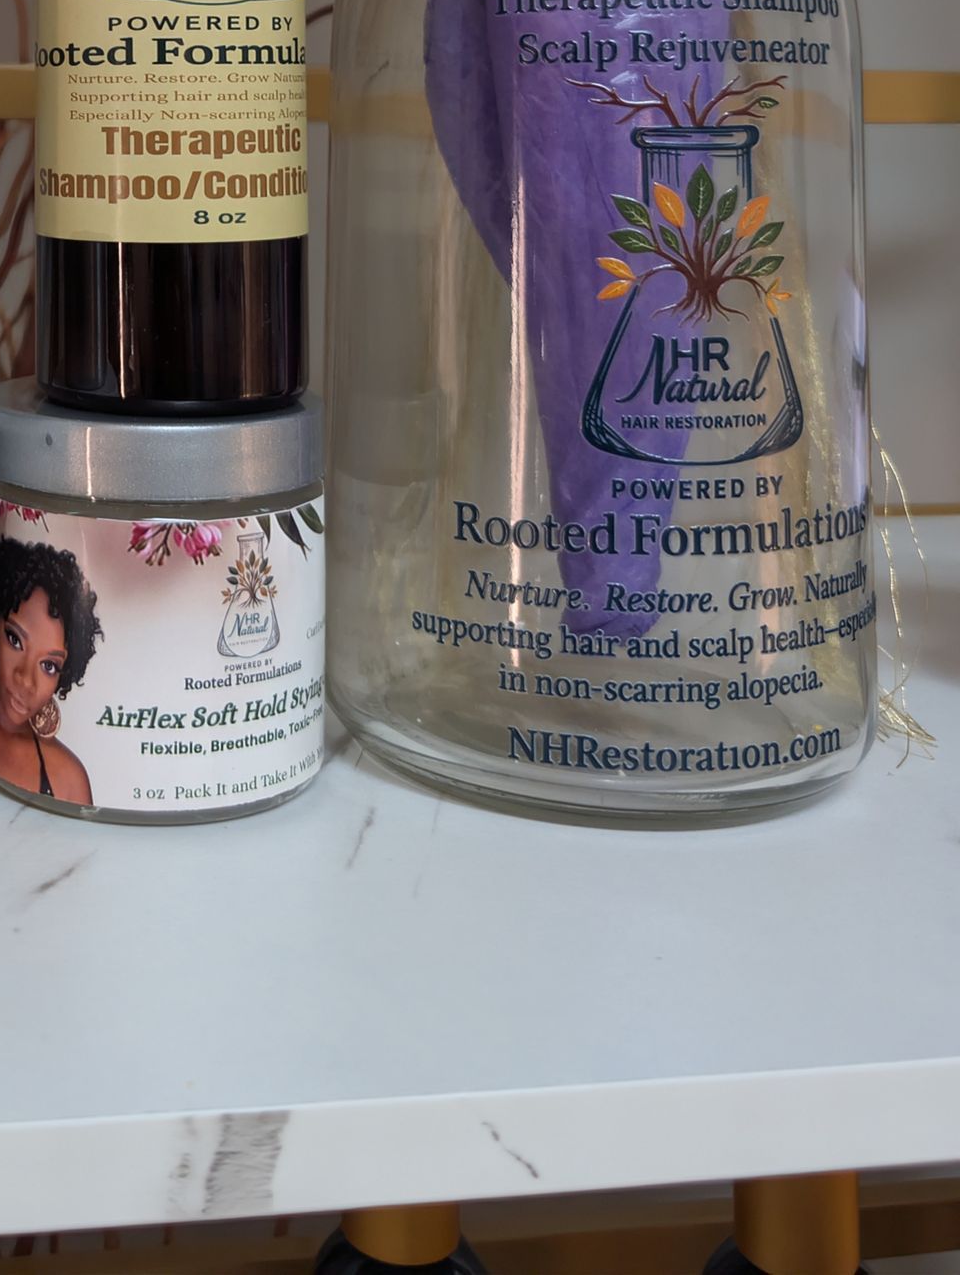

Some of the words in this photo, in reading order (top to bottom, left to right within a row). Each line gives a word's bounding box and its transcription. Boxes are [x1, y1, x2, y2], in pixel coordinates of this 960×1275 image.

[108, 16, 260, 31] POWERED
[271, 16, 293, 31] BY
[35, 37, 137, 67] ooted
[151, 37, 306, 66] Formula
[518, 30, 618, 72] Scalp
[628, 30, 831, 71] Rejuveneator
[68, 73, 137, 84] Nurture.
[144, 73, 221, 84] Restore.
[227, 73, 269, 83] Grow
[70, 91, 168, 105] Supporting
[175, 91, 212, 102] hair
[217, 91, 248, 101] and
[253, 90, 286, 102] scalp
[69, 110, 154, 122] Especially
[161, 109, 275, 122] Non-scarring
[101, 124, 301, 159] Therapeutic
[40, 166, 307, 204] Shampoo/Conditio
[194, 210, 209, 225] 8
[218, 212, 246, 224] oz
[615, 333, 770, 405] Natural
[621, 415, 658, 429] HAIR
[665, 414, 767, 429] RESTORATION
[611, 478, 745, 500] POWERED
[756, 476, 783, 497] BY
[454, 500, 618, 555] Rooted
[630, 502, 867, 556] Formulations
[465, 570, 590, 611] Nurture.
[603, 582, 718, 614] Restore.
[728, 582, 798, 611] Grow.
[804, 560, 867, 603] Naturally
[412, 610, 553, 659] supporting
[560, 630, 619, 658] hair
[626, 630, 680, 659] and
[689, 631, 754, 663] scalp
[184, 676, 232, 691] Rooted
[235, 659, 302, 686] Formulations
[224, 660, 262, 673] POWERED
[264, 658, 273, 667] BY
[498, 663, 527, 692] in
[534, 674, 720, 709] non-scarring
[726, 667, 824, 705] alopecia.
[96, 705, 187, 730] AirFlex
[192, 705, 238, 728] Soft
[243, 693, 287, 723] Hold
[141, 741, 207, 756] Flexible,
[210, 728, 287, 752] Breathable,
[508, 726, 843, 773] NHRestoration.com
[133, 787, 141, 799] 3
[146, 789, 165, 800] oz
[175, 784, 212, 800] Pack
[215, 782, 228, 796] It
[231, 776, 258, 794] and
[260, 770, 288, 791] Take
[289, 763, 298, 778] It
